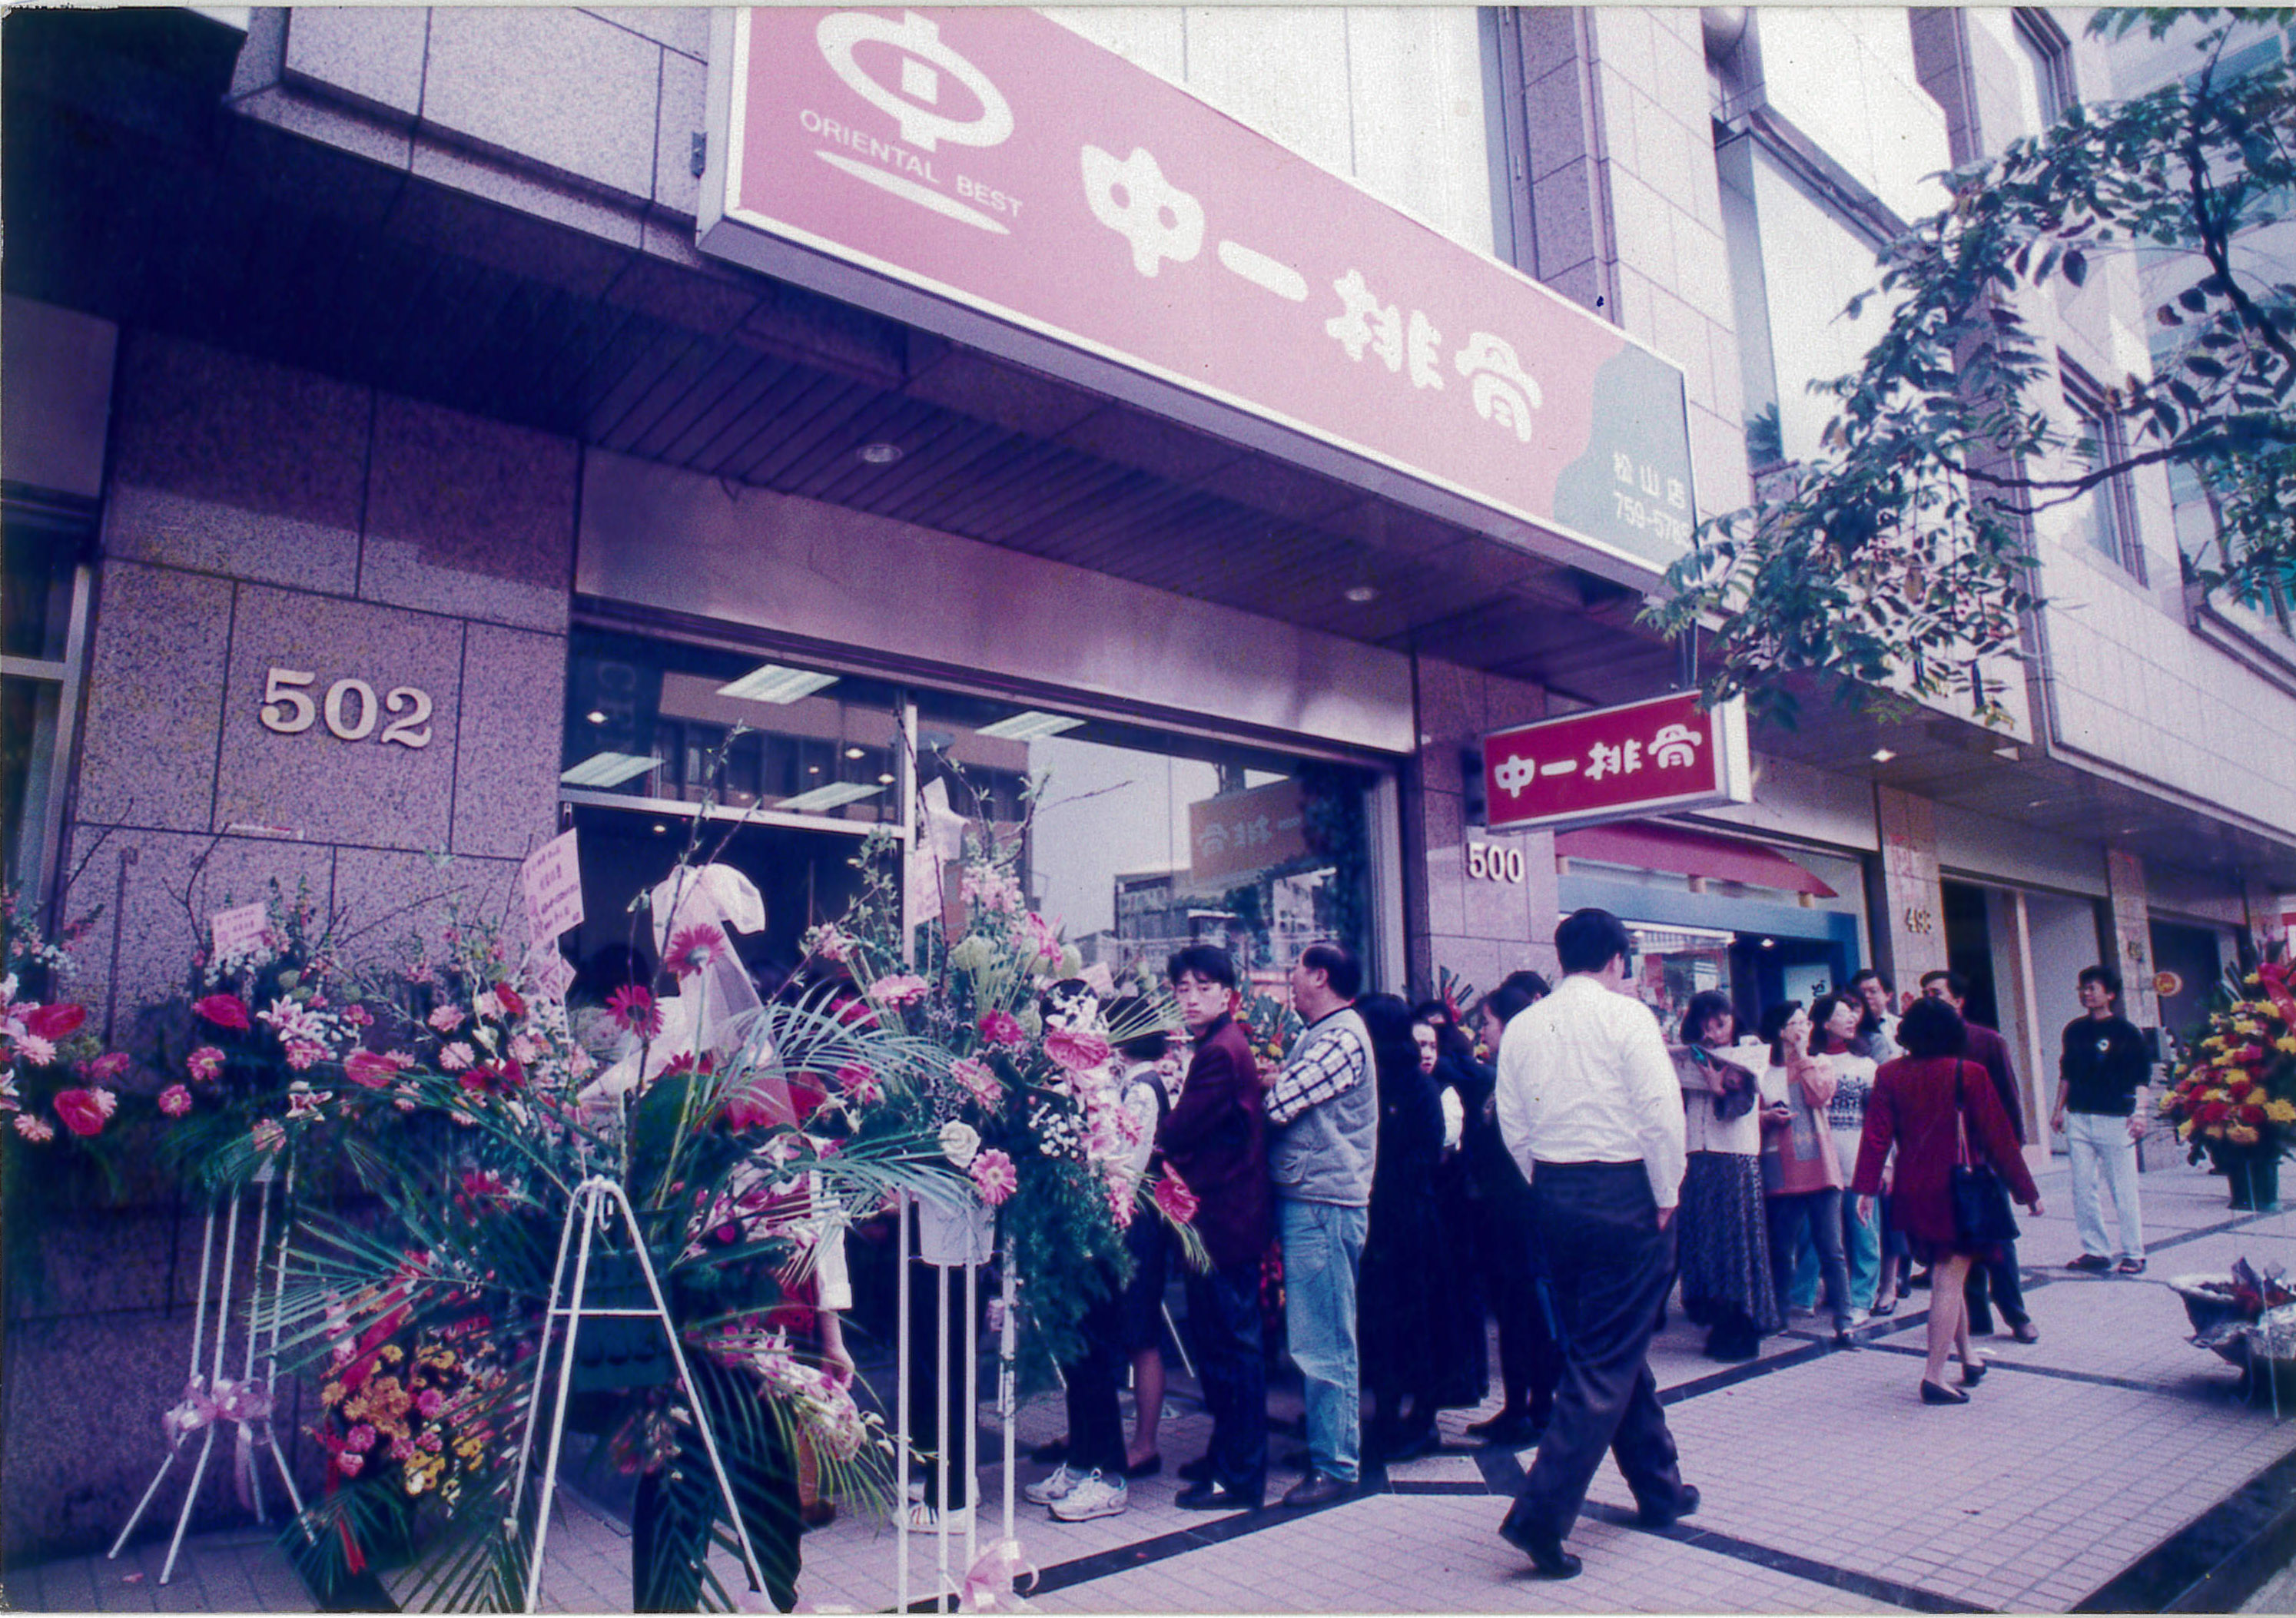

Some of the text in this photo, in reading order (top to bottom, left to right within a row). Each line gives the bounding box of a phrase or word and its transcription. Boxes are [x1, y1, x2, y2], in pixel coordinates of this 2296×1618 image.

[799, 109, 1023, 217] ORIENTAL BEST
[1080, 144, 1542, 443] 中一排骨
[260, 667, 433, 748] 502
[1494, 723, 1702, 799] 中一排骨
[1466, 841, 1525, 884] 500
